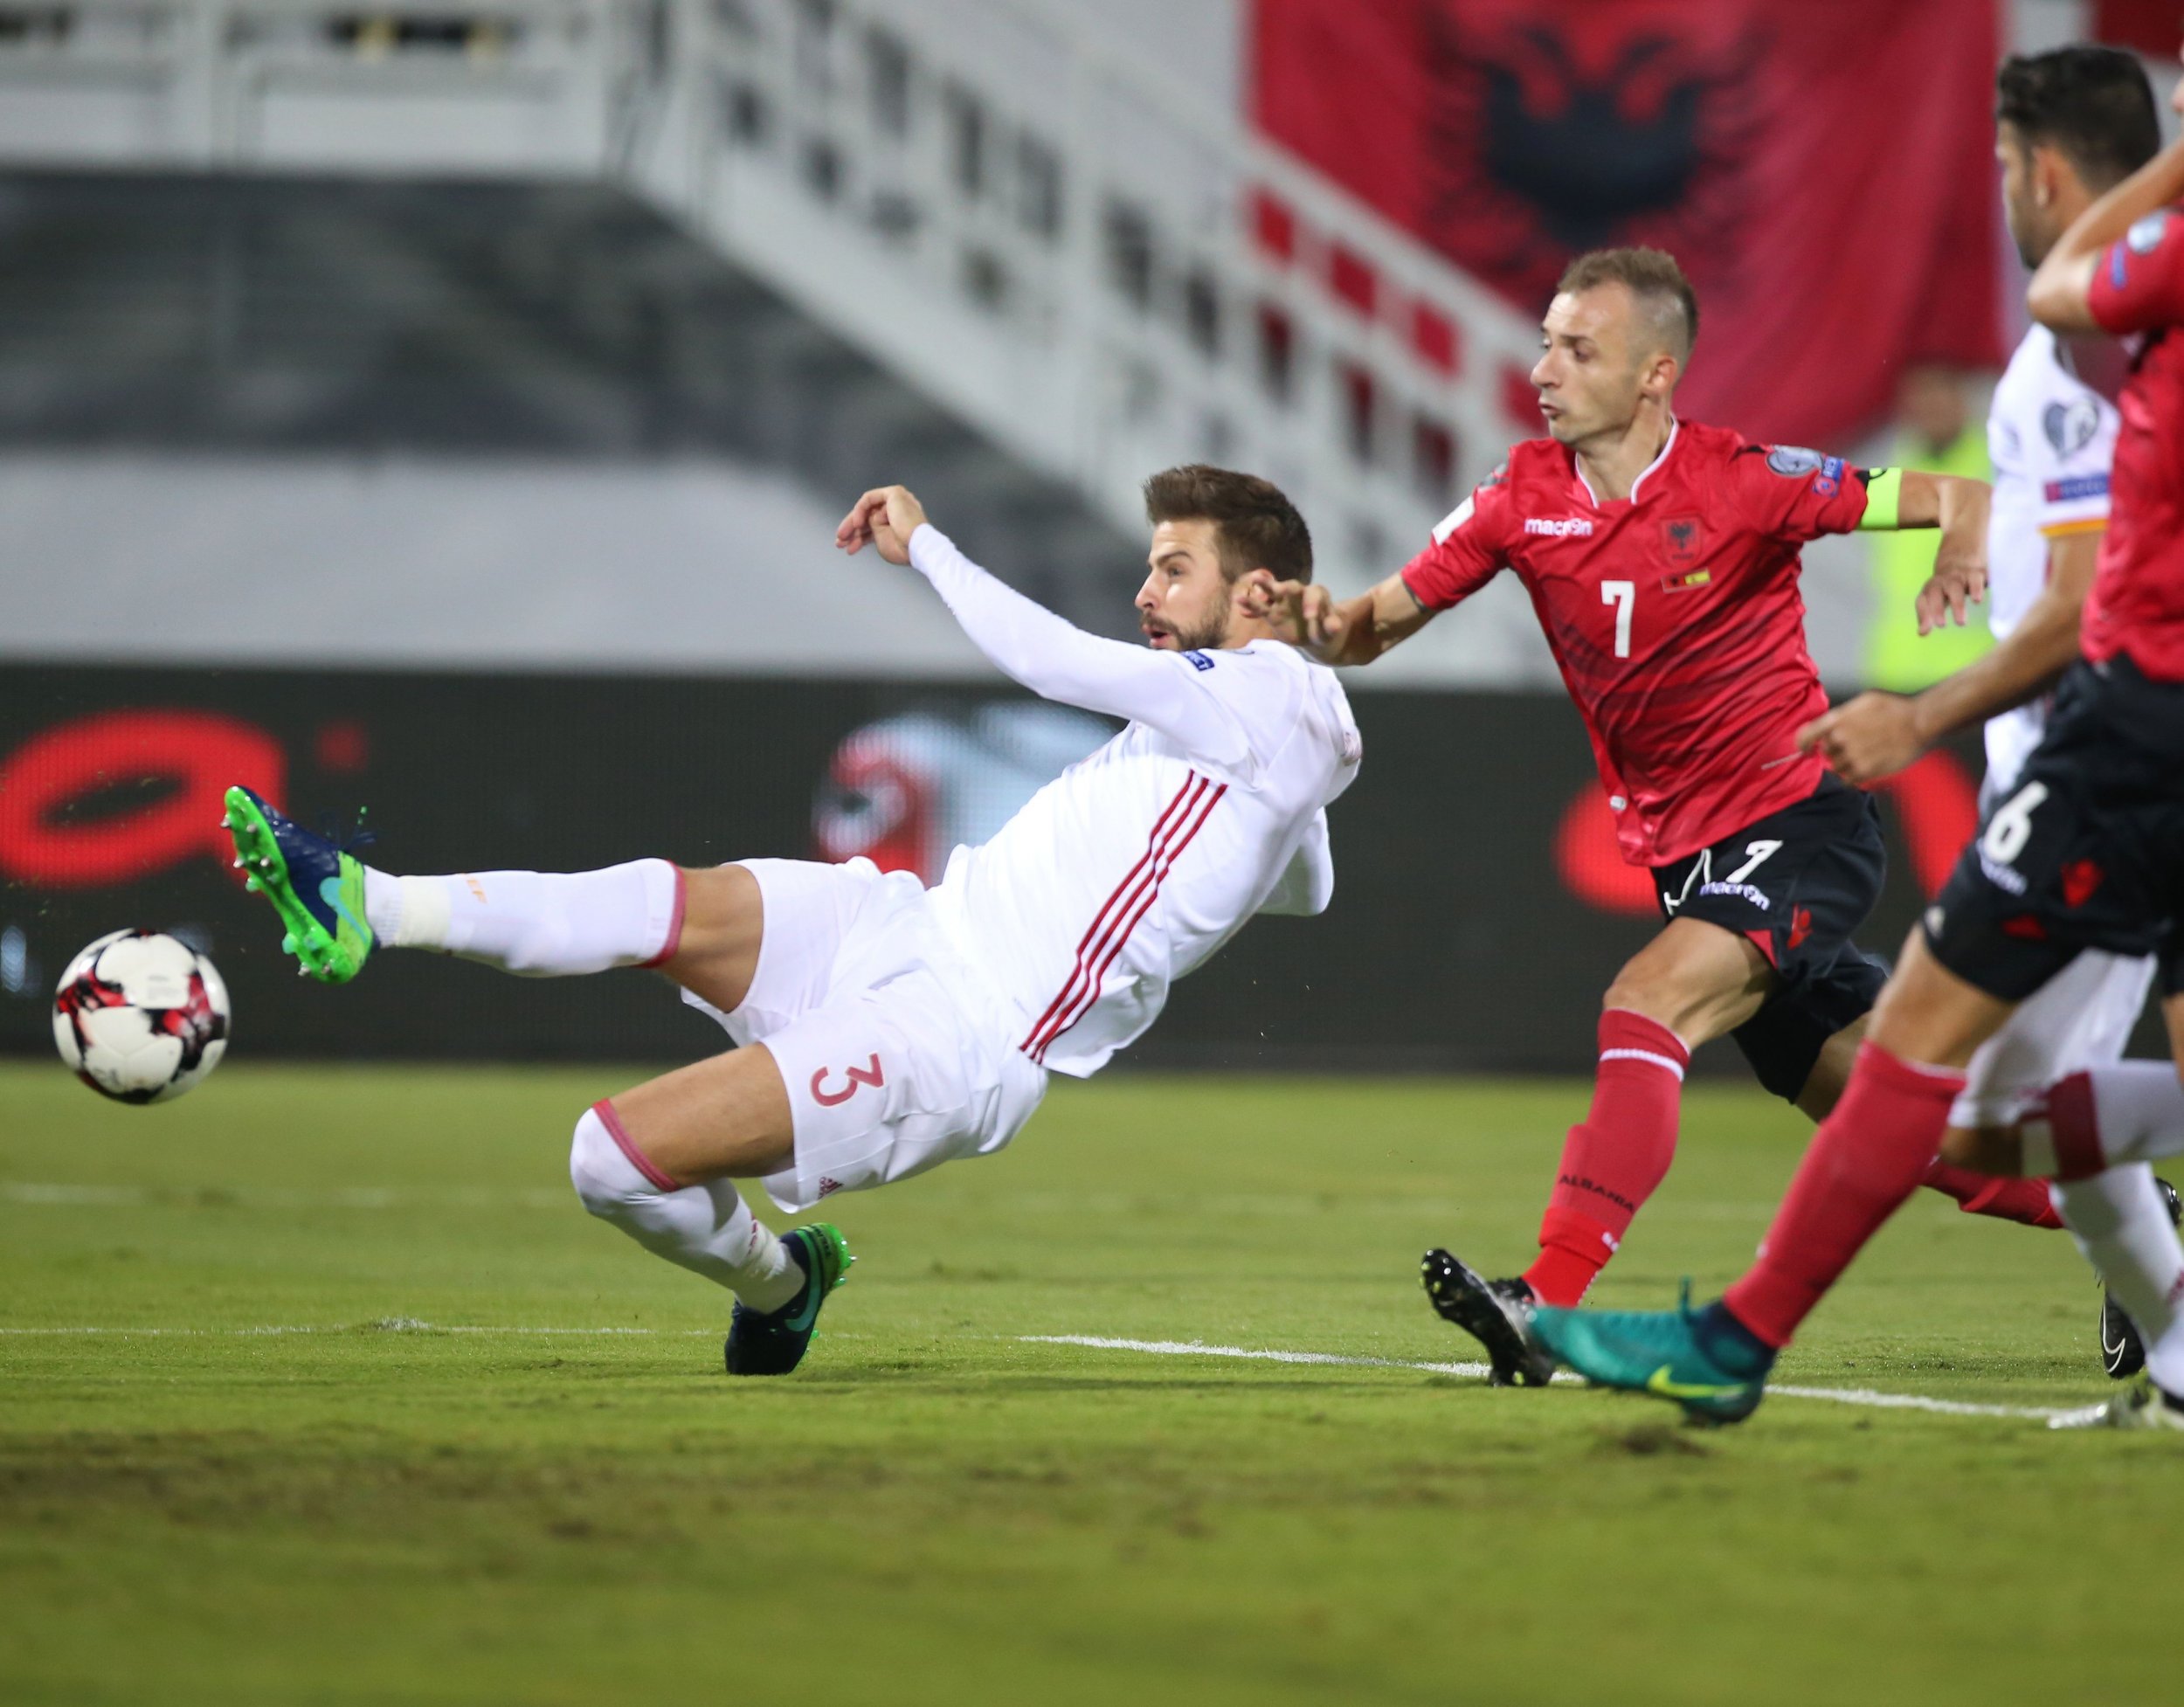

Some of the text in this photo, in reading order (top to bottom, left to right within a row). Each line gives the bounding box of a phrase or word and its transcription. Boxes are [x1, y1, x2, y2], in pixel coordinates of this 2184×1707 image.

[1524, 518, 1593, 537] macron
[1600, 580, 1635, 659] 7
[1983, 779, 2049, 865] 6
[1725, 840, 1784, 884] 7
[1699, 881, 1771, 911] macron
[811, 1051, 884, 1107] 3
